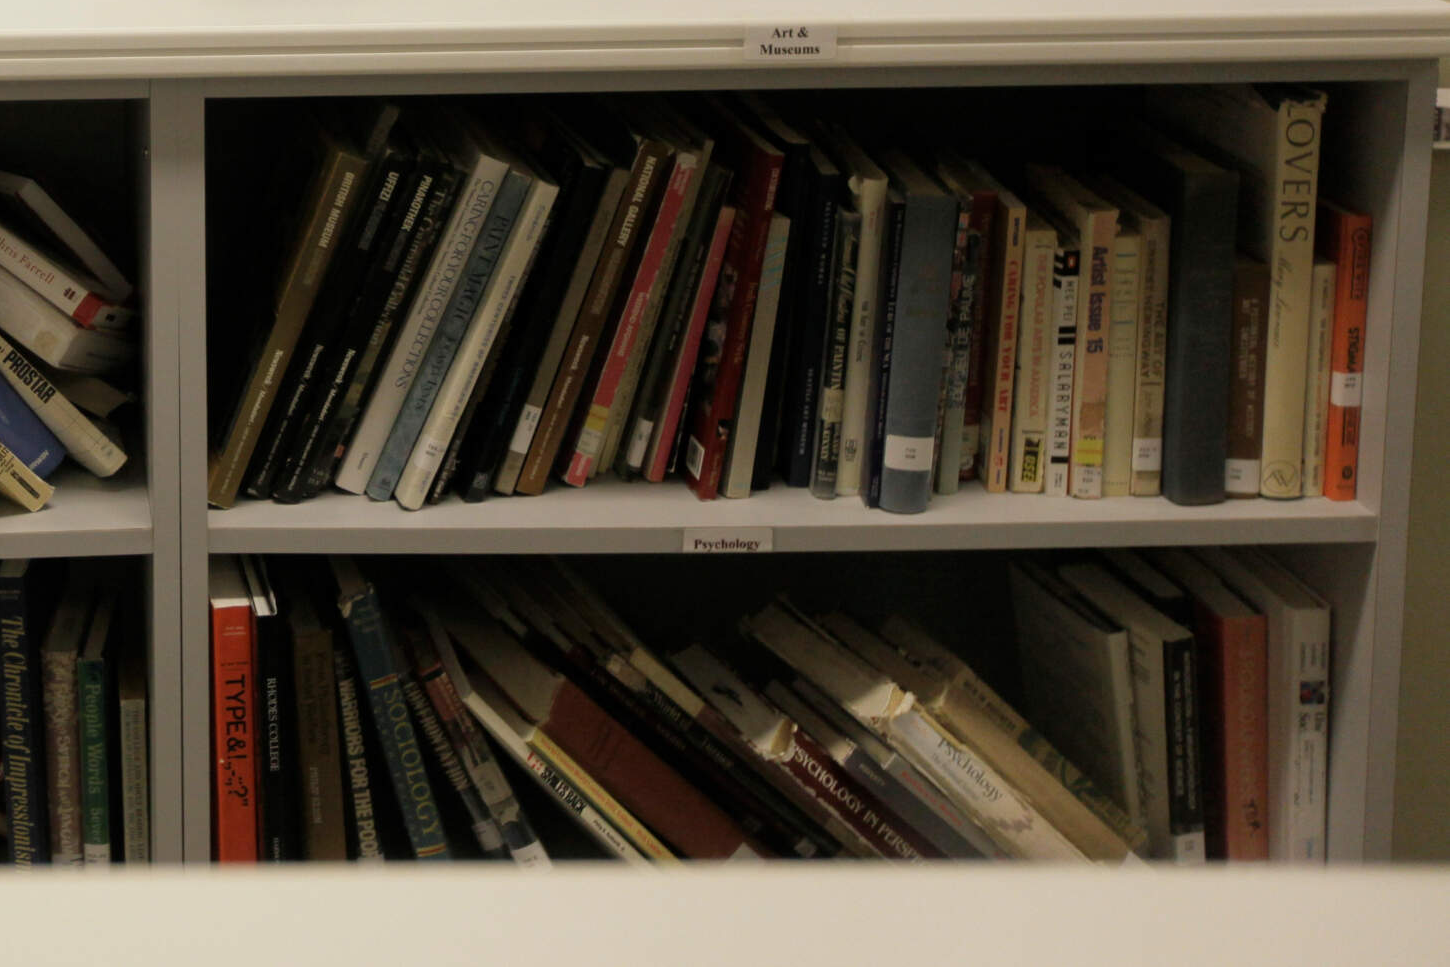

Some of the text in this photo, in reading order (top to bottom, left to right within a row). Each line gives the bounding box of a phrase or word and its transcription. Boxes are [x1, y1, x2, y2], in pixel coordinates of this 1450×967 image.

[760, 44, 820, 55] Museums
[772, 26, 808, 38] Art &
[378, 170, 400, 202] UFFIZI
[400, 174, 434, 233] PINAKOTHEK
[425, 186, 449, 217] The
[616, 155, 656, 247] NATIONAL GALLERY
[1279, 100, 1316, 244] LOVERS
[316, 171, 356, 249] BRITISH MUSEUM
[462, 178, 495, 235] CARING
[17, 255, 56, 285] Farrell
[433, 258, 460, 298] YOUR
[449, 231, 472, 262] FOR
[450, 213, 510, 327] PAINT MAGIC
[1086, 245, 1108, 354] Artist Issue 15
[393, 294, 444, 390] COLLECTIONS
[998, 260, 1019, 412] CARING FOR YOUR ART
[1139, 294, 1153, 378] HEMINGWAY
[3, 348, 57, 404] PROSTAR
[1053, 350, 1074, 454] SALARYMAN
[694, 539, 760, 552] Psychology
[0, 616, 25, 649] The
[2, 651, 30, 731] Chronicle
[3, 735, 31, 753] of
[83, 684, 105, 794] People Words
[261, 676, 286, 772] RHODES COLLEGE
[335, 679, 374, 819] WARRIORS FOR THE
[382, 690, 444, 836] SOCIOLOGY
[935, 735, 1004, 804] Psychology
[562, 784, 588, 815] BACK
[863, 807, 881, 830] IN
